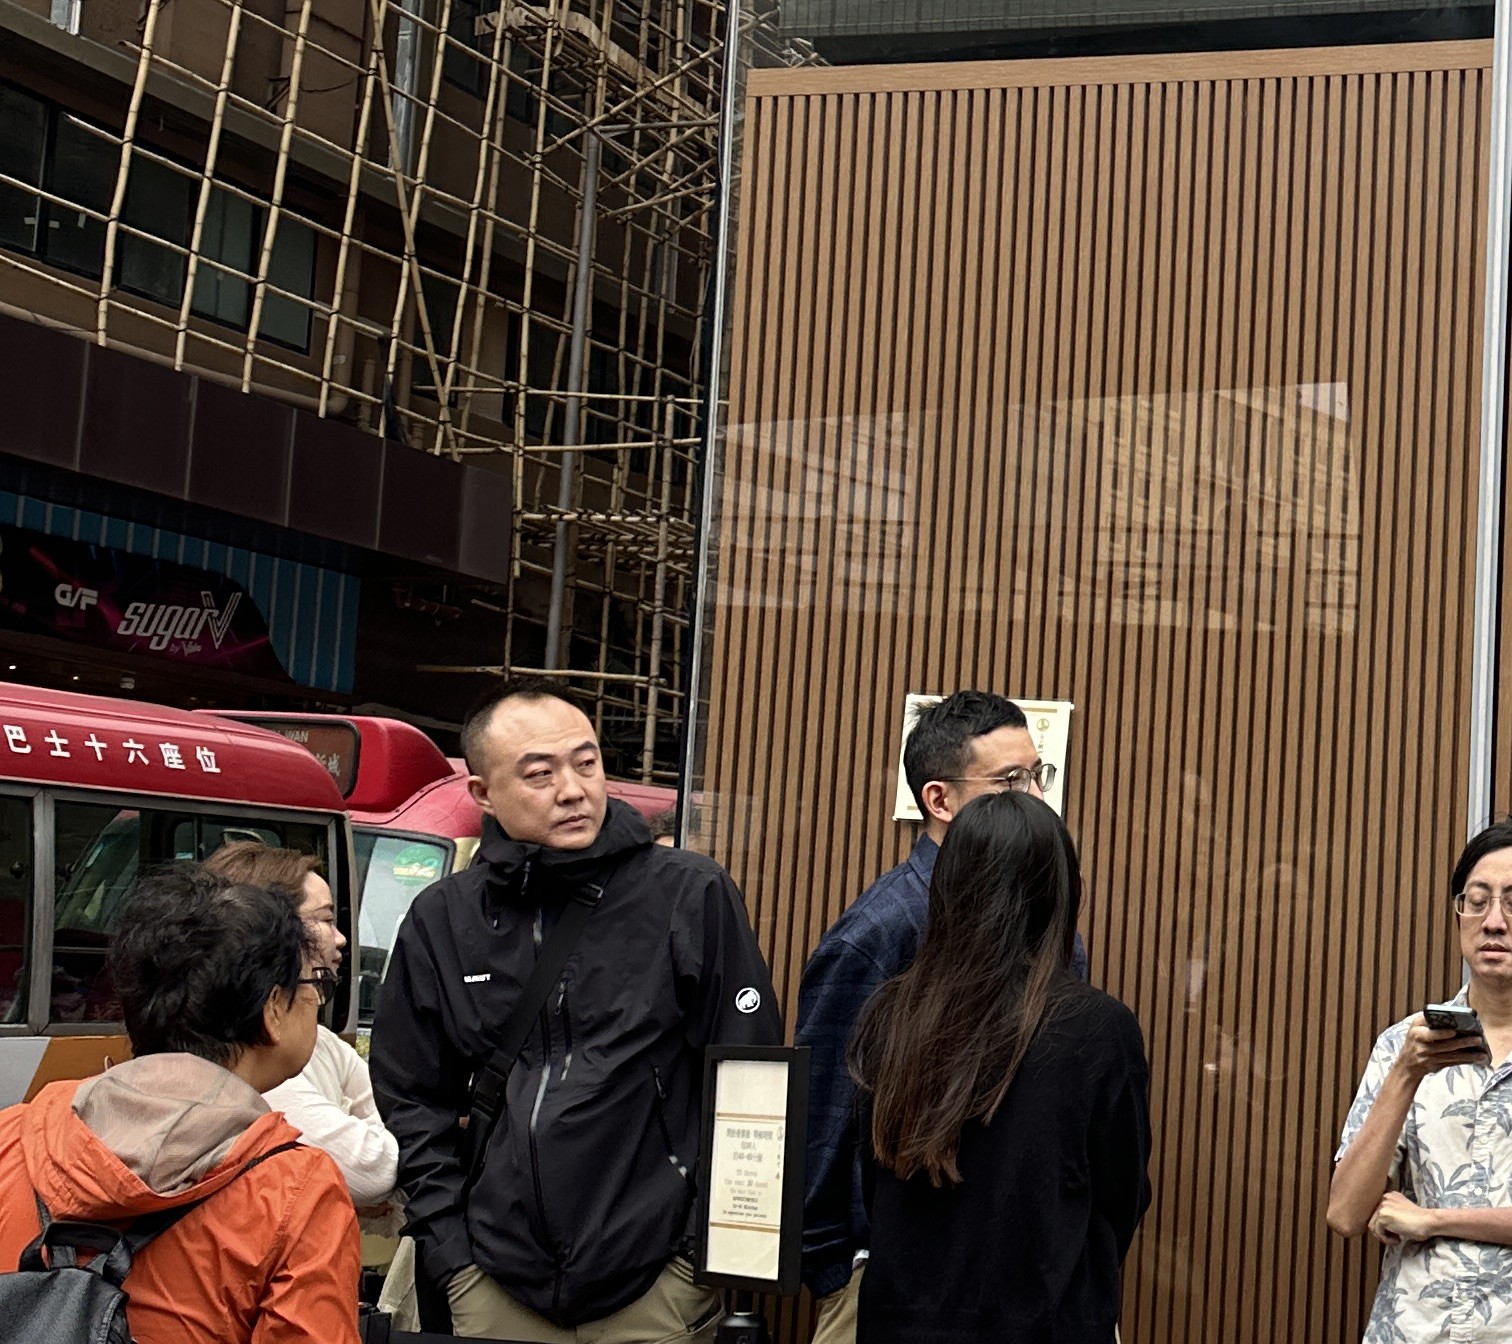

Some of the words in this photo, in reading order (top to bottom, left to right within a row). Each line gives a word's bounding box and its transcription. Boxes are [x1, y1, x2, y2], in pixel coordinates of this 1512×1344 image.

[54, 583, 98, 610] G/F
[3, 724, 221, 774] 巴士十六座位
